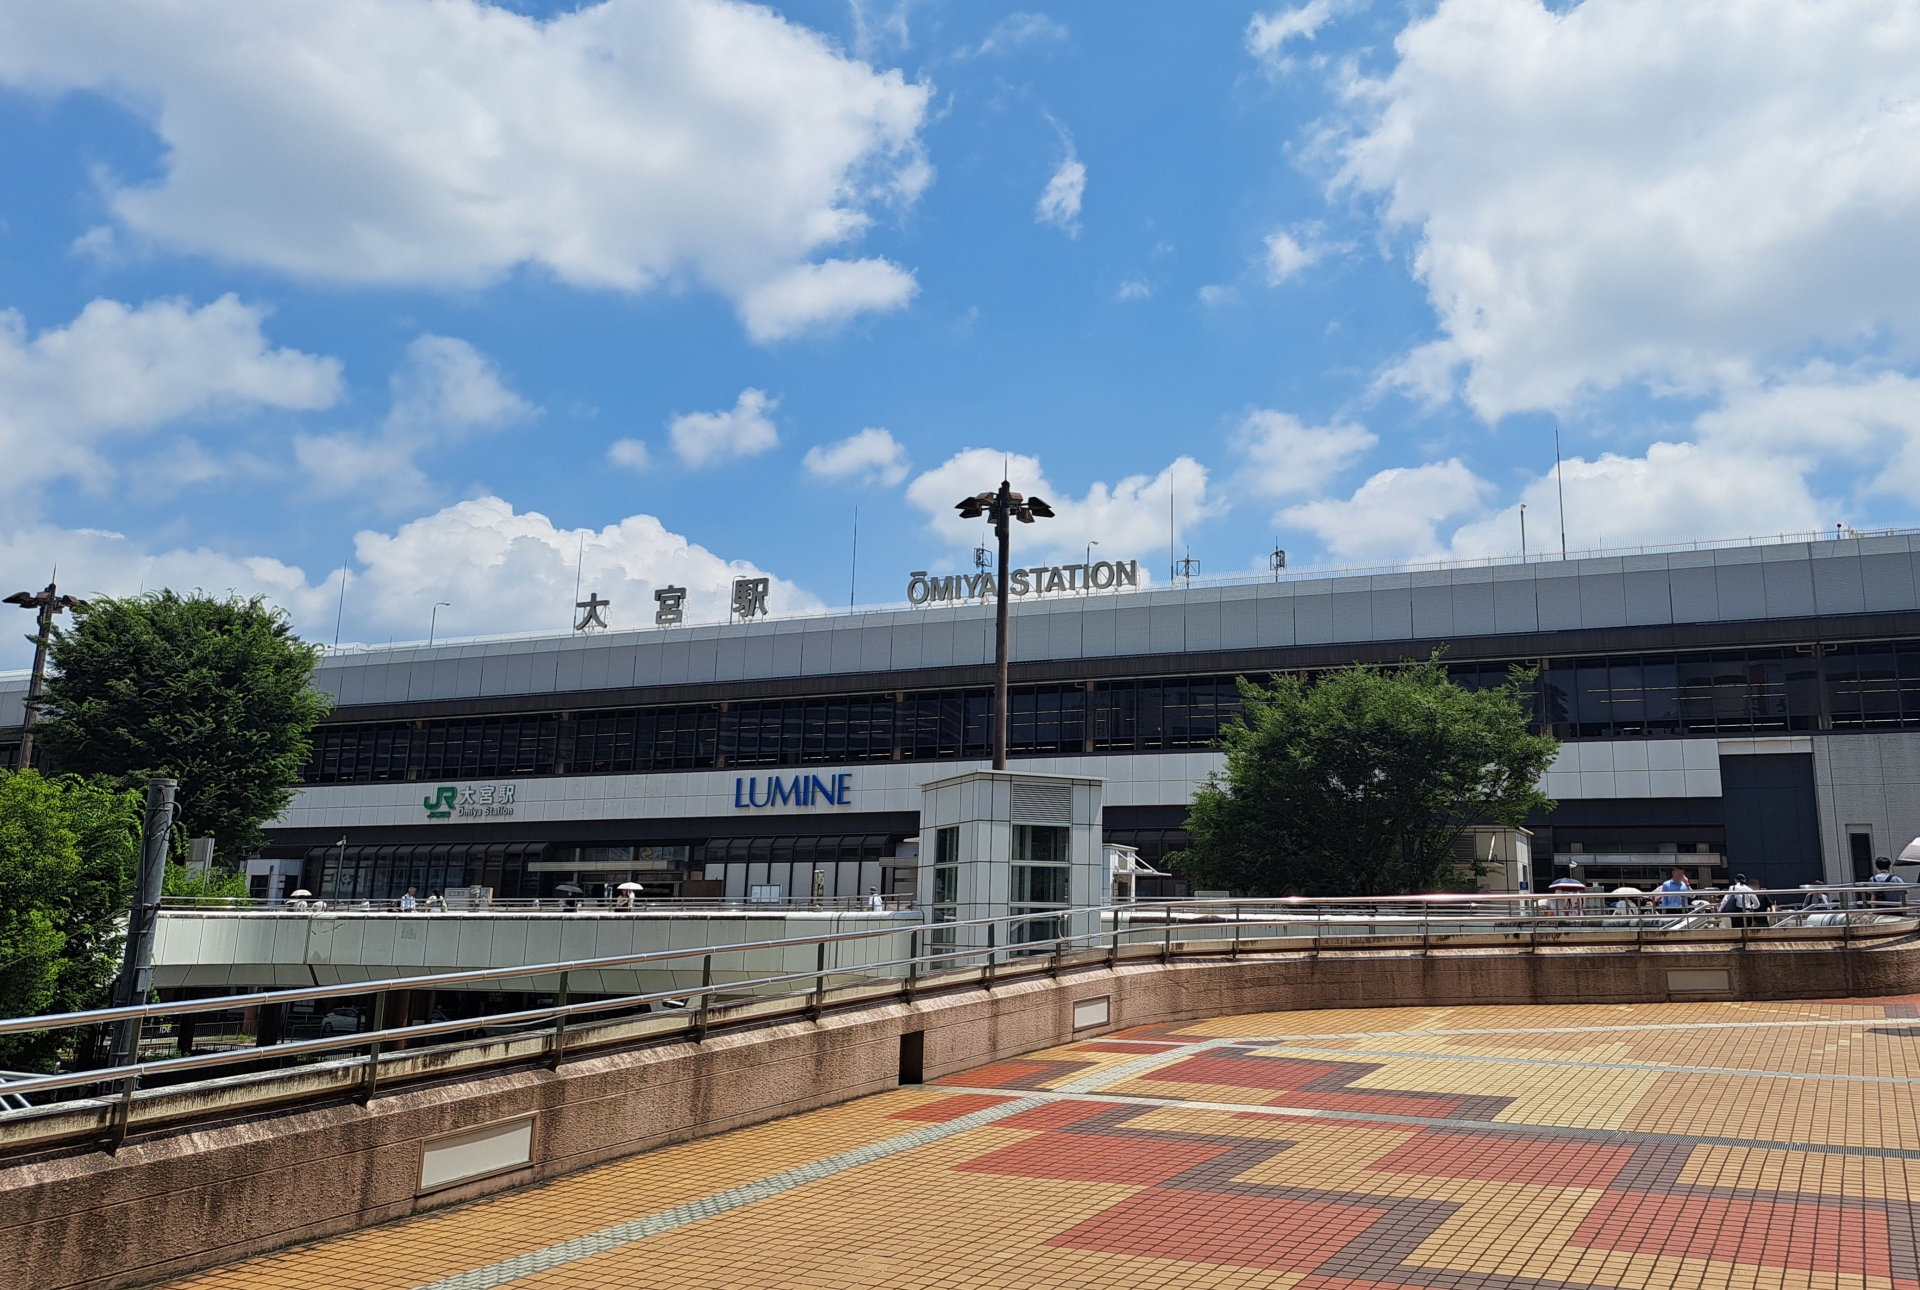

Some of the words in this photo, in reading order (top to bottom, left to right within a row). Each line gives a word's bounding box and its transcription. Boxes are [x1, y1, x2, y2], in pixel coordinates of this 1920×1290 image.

[907, 571, 998, 604] ŌMIYA
[1010, 560, 1137, 596] STATION
[576, 578, 769, 631] 大宮駅
[423, 786, 457, 810] JR
[460, 785, 515, 805] 大宮駅
[734, 773, 852, 808] LUMINE
[458, 806, 483, 818] Omiya
[484, 805, 514, 817] Station
